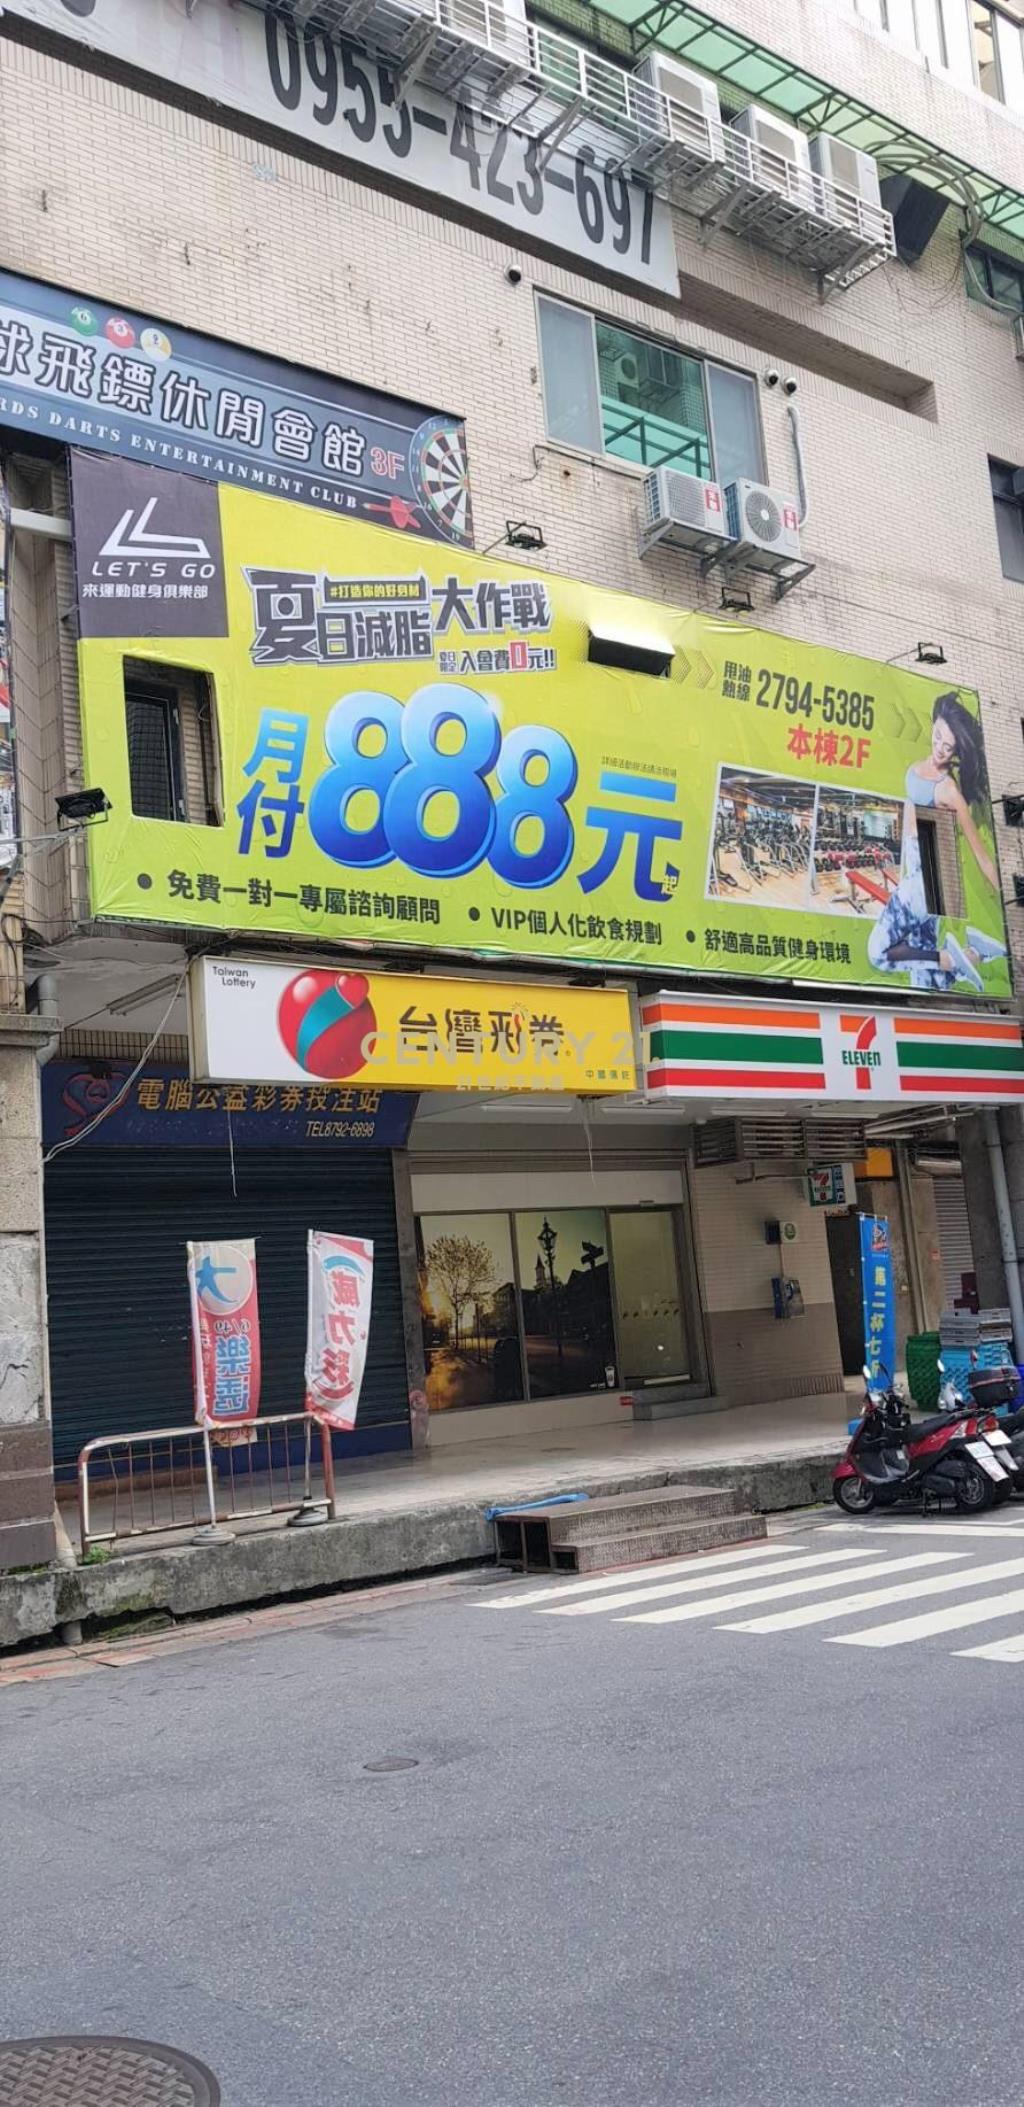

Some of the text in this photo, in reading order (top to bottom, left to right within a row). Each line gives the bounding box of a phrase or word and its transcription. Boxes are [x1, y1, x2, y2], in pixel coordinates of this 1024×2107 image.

[50, 411, 121, 442] DARTS
[131, 434, 304, 493] ENTERTAINMENT
[310, 486, 357, 508] CLUB
[370, 446, 406, 479] 3F
[92, 561, 216, 578] LET'S GO
[82, 583, 209, 599] 來運動健身俱樂部
[756, 668, 875, 731] 2794-5385
[787, 723, 872, 768] 本棟2F
[236, 707, 309, 858] 月付
[168, 869, 440, 924] 免費一對一專屬諮詢顧問
[491, 907, 662, 945] VIP個人化飲食規劃
[705, 928, 851, 964] 舒適高品質健身環境
[212, 966, 249, 977] Taiwan
[222, 977, 256, 989] Lottery
